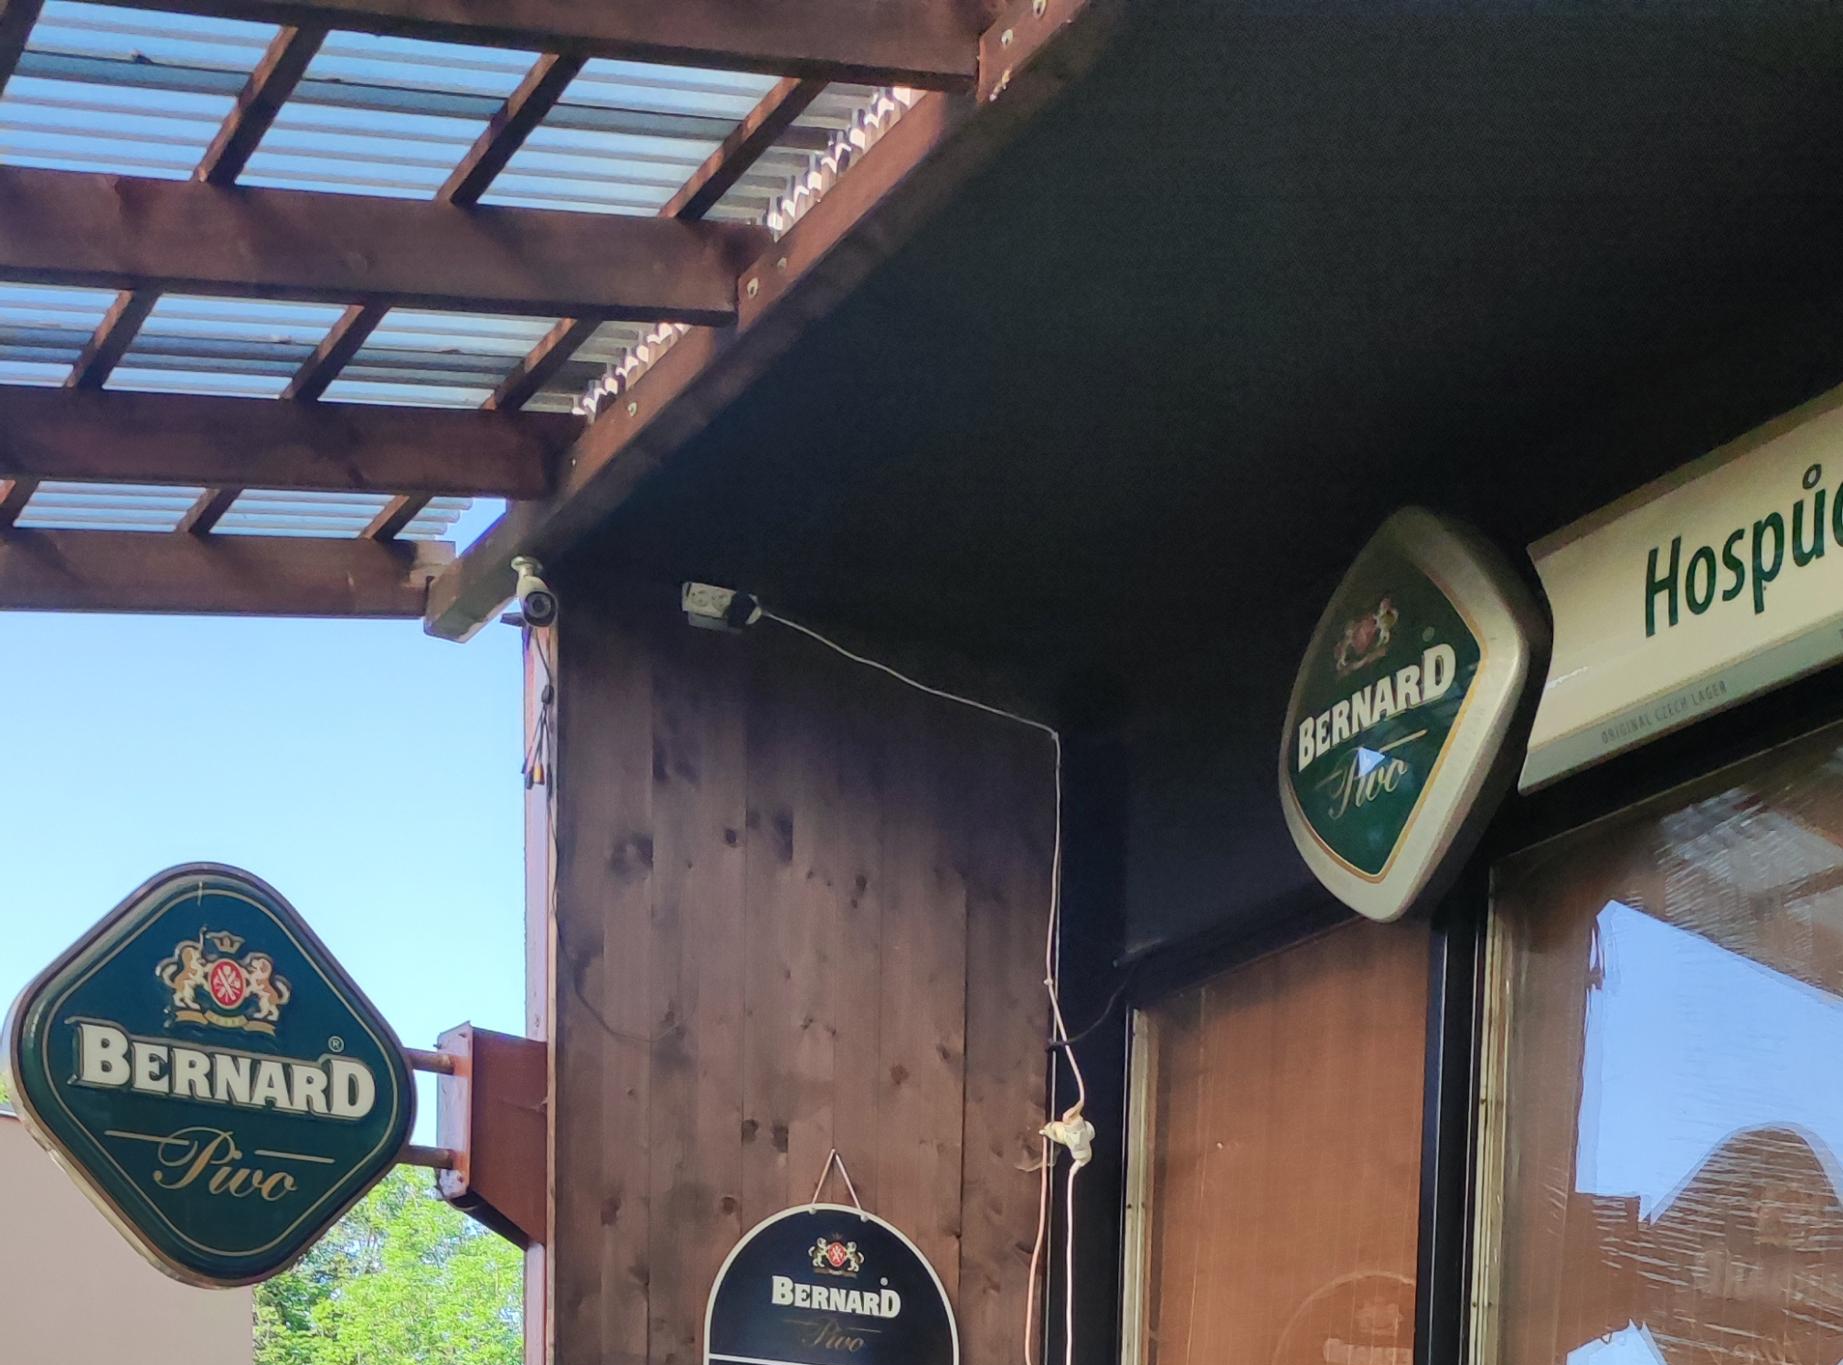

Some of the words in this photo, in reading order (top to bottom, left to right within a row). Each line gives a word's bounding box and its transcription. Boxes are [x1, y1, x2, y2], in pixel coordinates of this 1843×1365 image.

[1298, 643, 1456, 772] BERNARD
[1600, 715, 1650, 744] ORIGINAL
[1654, 700, 1687, 721] CZECH
[1690, 680, 1728, 706] LAGER
[75, 1021, 376, 1120] BERNARD
[154, 1126, 298, 1201] Pivo
[771, 1275, 901, 1318] BERNARD
[801, 1316, 865, 1351] Pivo
